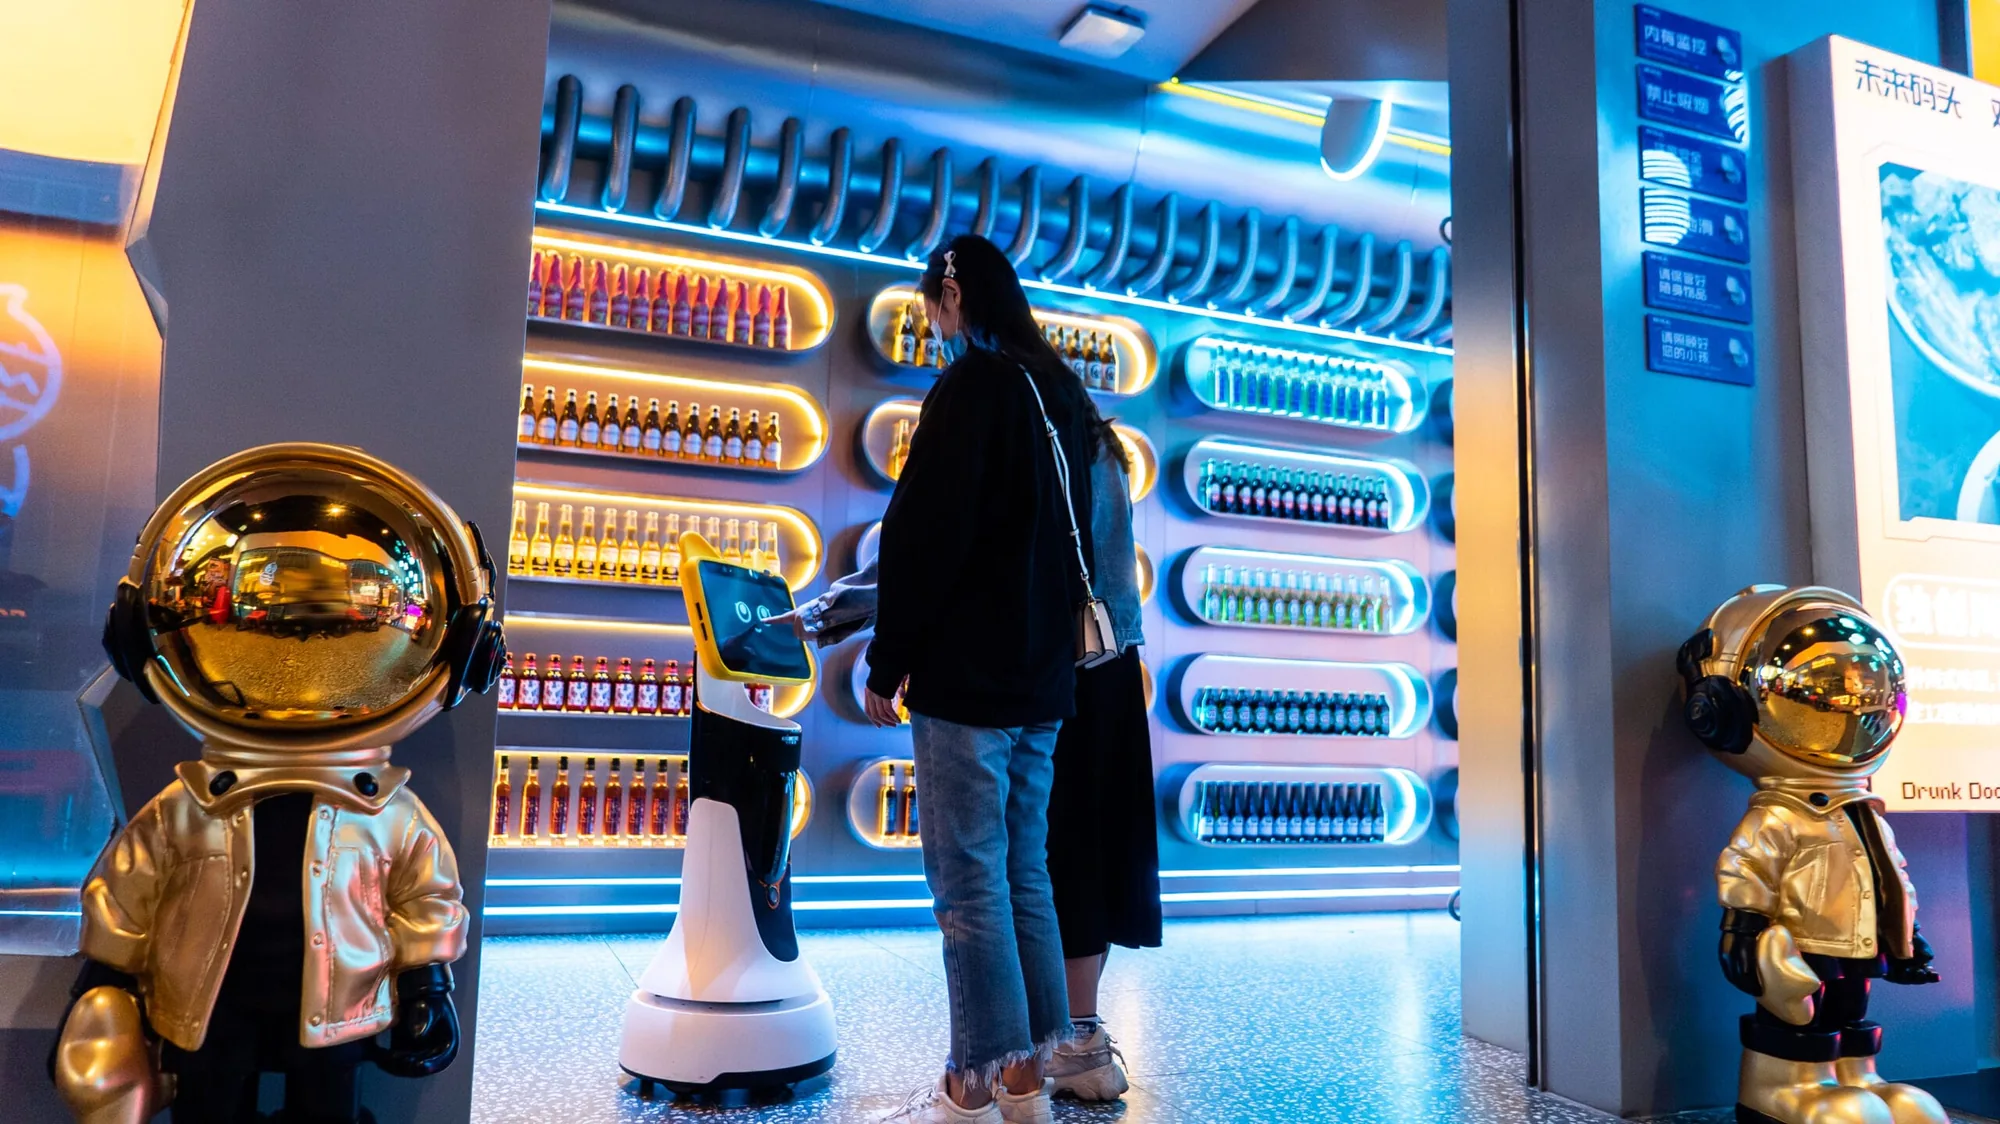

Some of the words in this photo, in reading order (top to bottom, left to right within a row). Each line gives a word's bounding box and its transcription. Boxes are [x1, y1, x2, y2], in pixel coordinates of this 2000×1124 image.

[1855, 60, 1962, 119] 未来码头
[1902, 782, 1962, 800] Drunk
